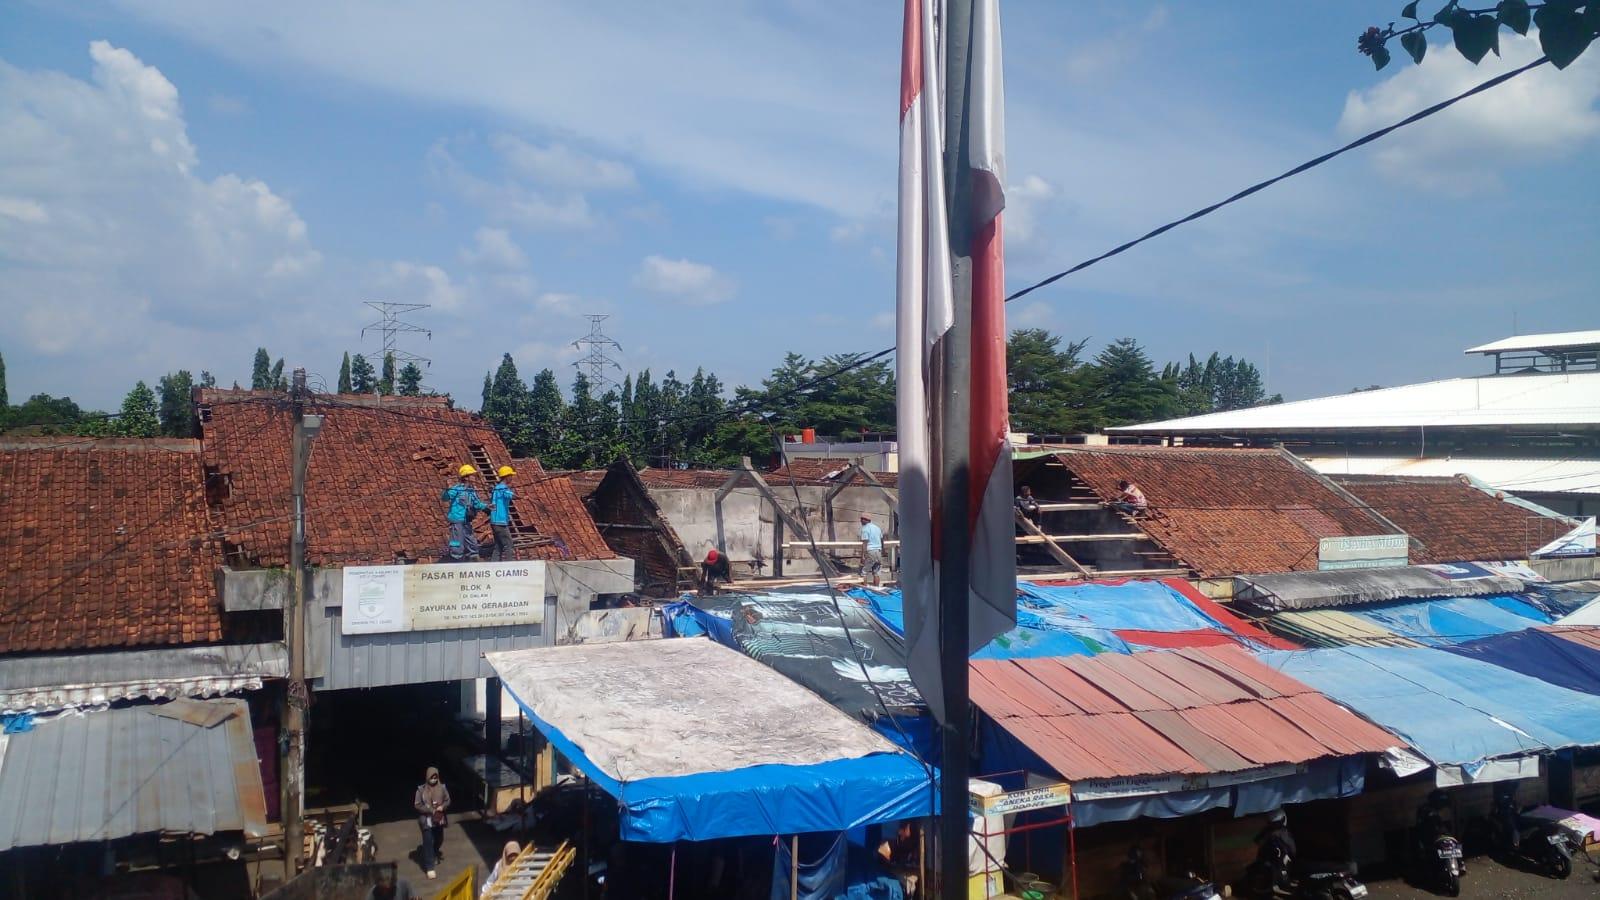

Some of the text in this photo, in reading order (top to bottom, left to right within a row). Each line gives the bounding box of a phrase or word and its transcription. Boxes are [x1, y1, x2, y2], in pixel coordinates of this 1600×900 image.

[421, 568, 529, 581] PASAR MANIS CIAMIS
[460, 584, 481, 592] BLOK
[419, 601, 529, 613] SAYURAN DAN GERABADAN
